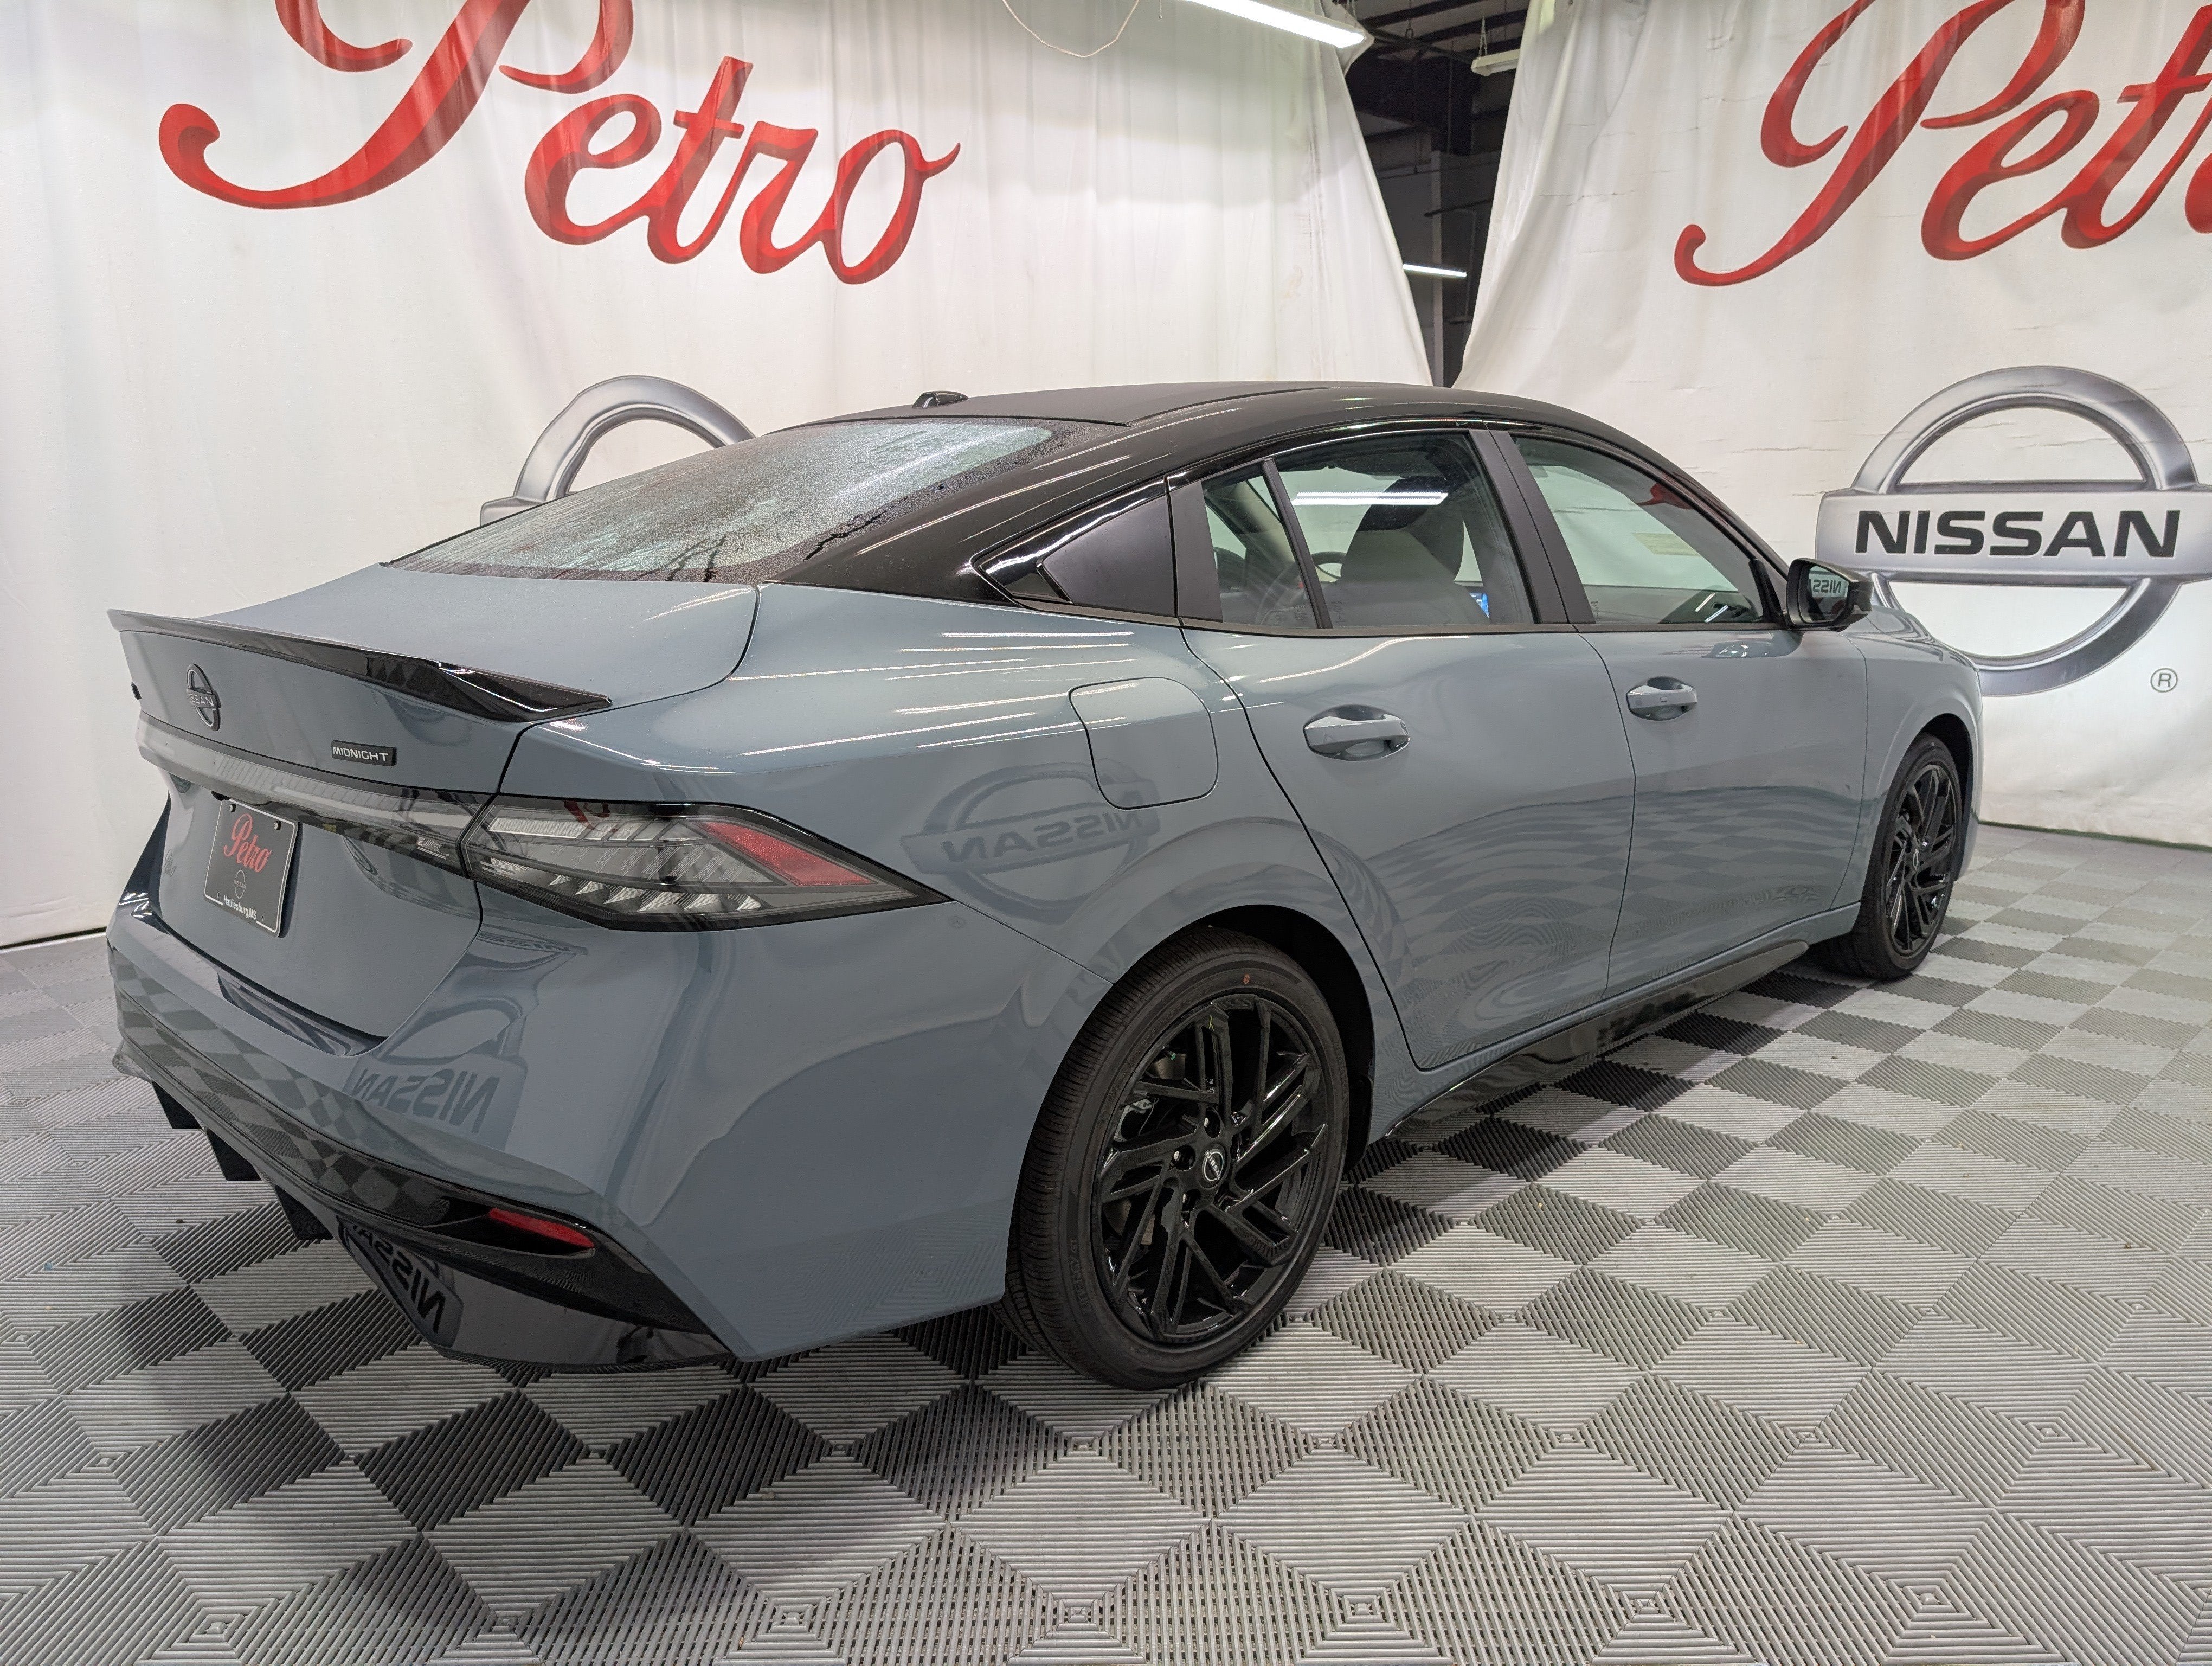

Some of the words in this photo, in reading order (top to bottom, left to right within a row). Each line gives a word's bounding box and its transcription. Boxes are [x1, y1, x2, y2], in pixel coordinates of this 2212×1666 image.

[158, 0, 961, 285] Petro
[1674, 0, 2212, 287] Pet
[1854, 509, 2181, 558] NISSAN
[332, 746, 389, 761] MIDNIGHT
[223, 813, 272, 872] Petro
[1205, 1150, 1221, 1181] NISSAN
